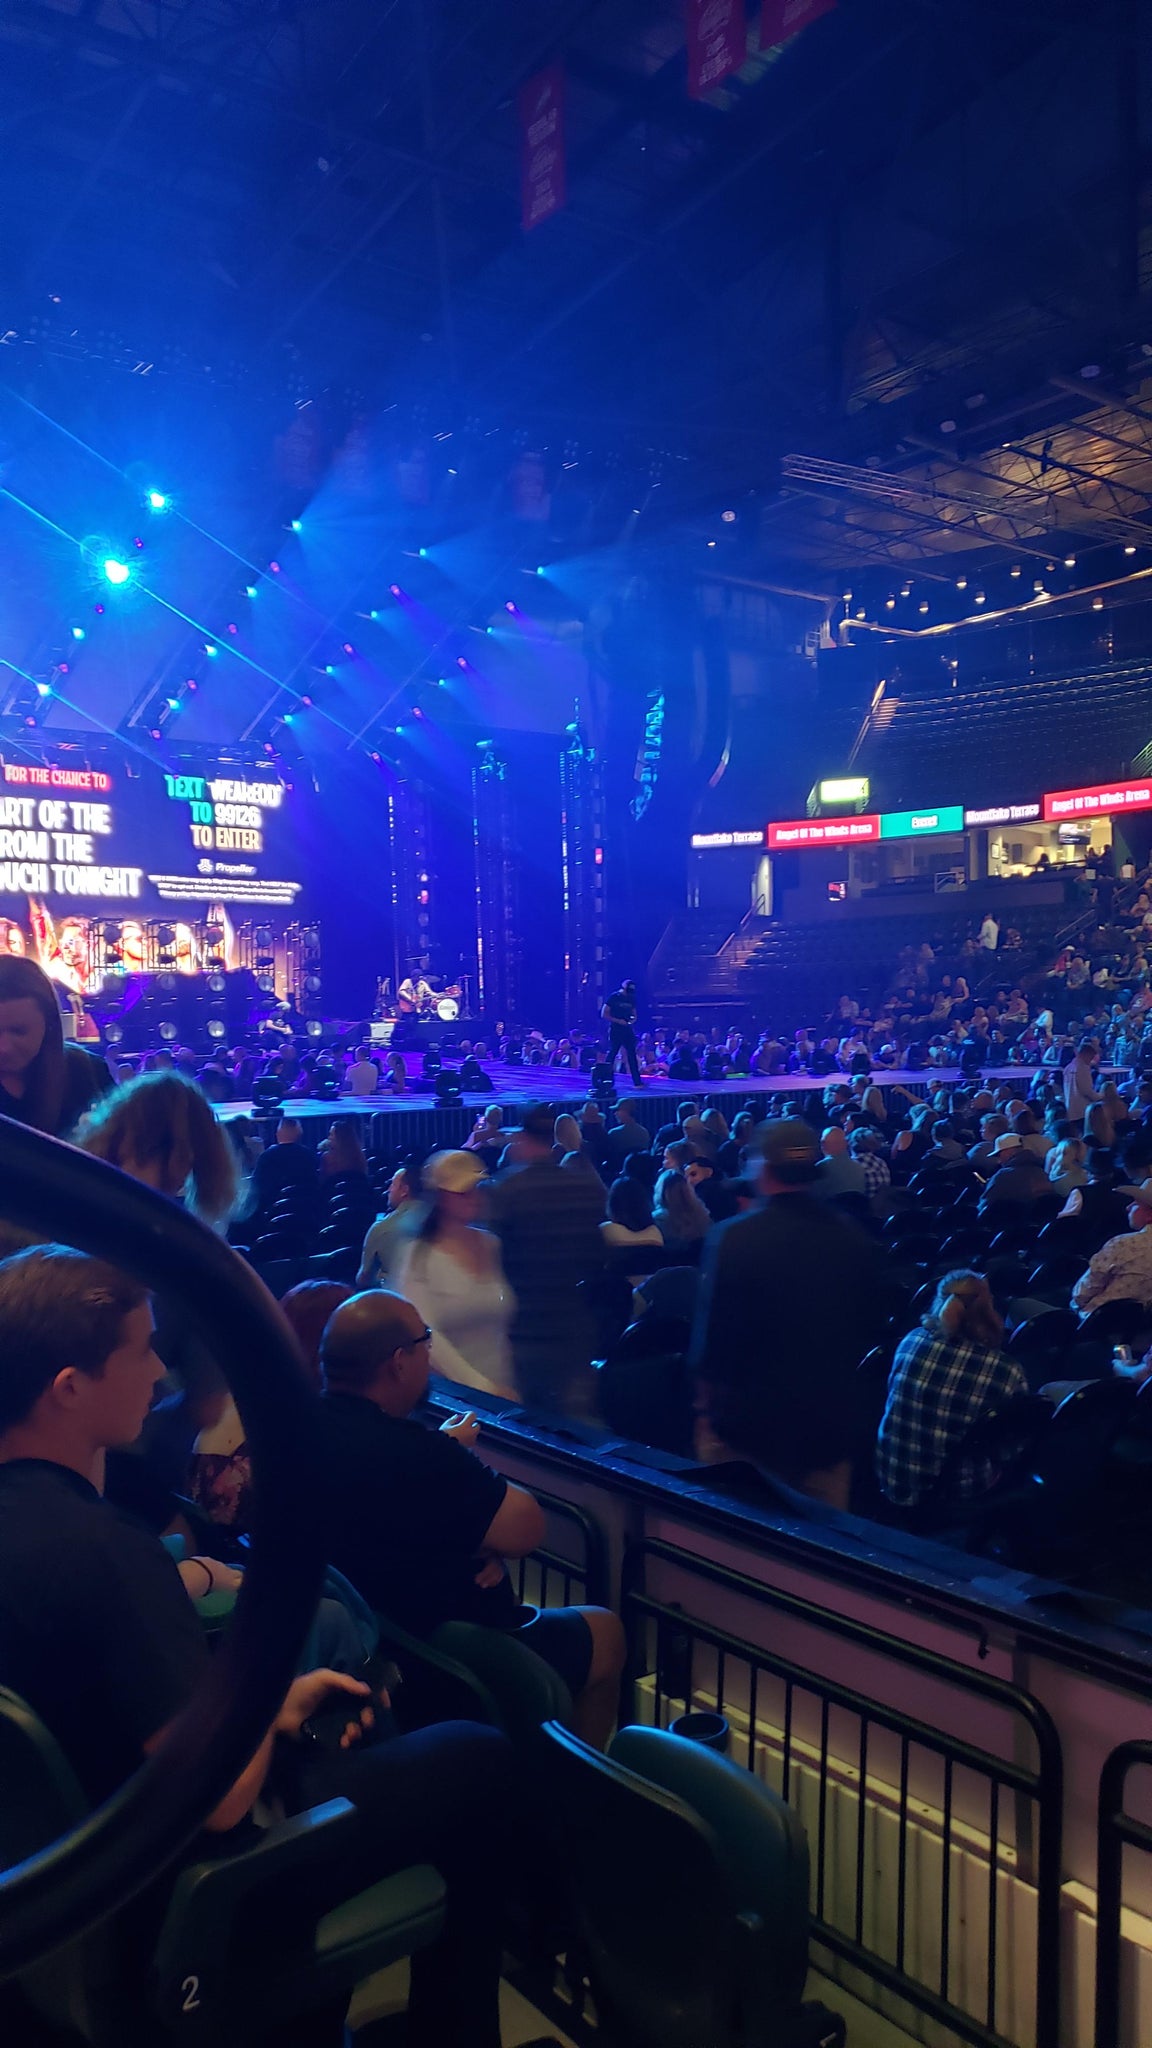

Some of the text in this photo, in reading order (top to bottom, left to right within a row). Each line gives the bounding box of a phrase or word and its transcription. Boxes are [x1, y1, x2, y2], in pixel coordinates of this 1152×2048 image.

[5, 765, 108, 788] FOR THE CHANCE TO
[164, 774, 205, 800] TEXT
[190, 801, 262, 828] TO 99126
[1009, 804, 1040, 818] Terrace
[1084, 796, 1099, 808] The
[38, 799, 67, 830] OF
[69, 801, 111, 834] THE
[51, 832, 93, 863] THE
[190, 824, 263, 852] TO ENTER
[50, 864, 142, 898] TONIGHT
[215, 862, 256, 874] Propeller
[181, 1975, 201, 2010] 2
